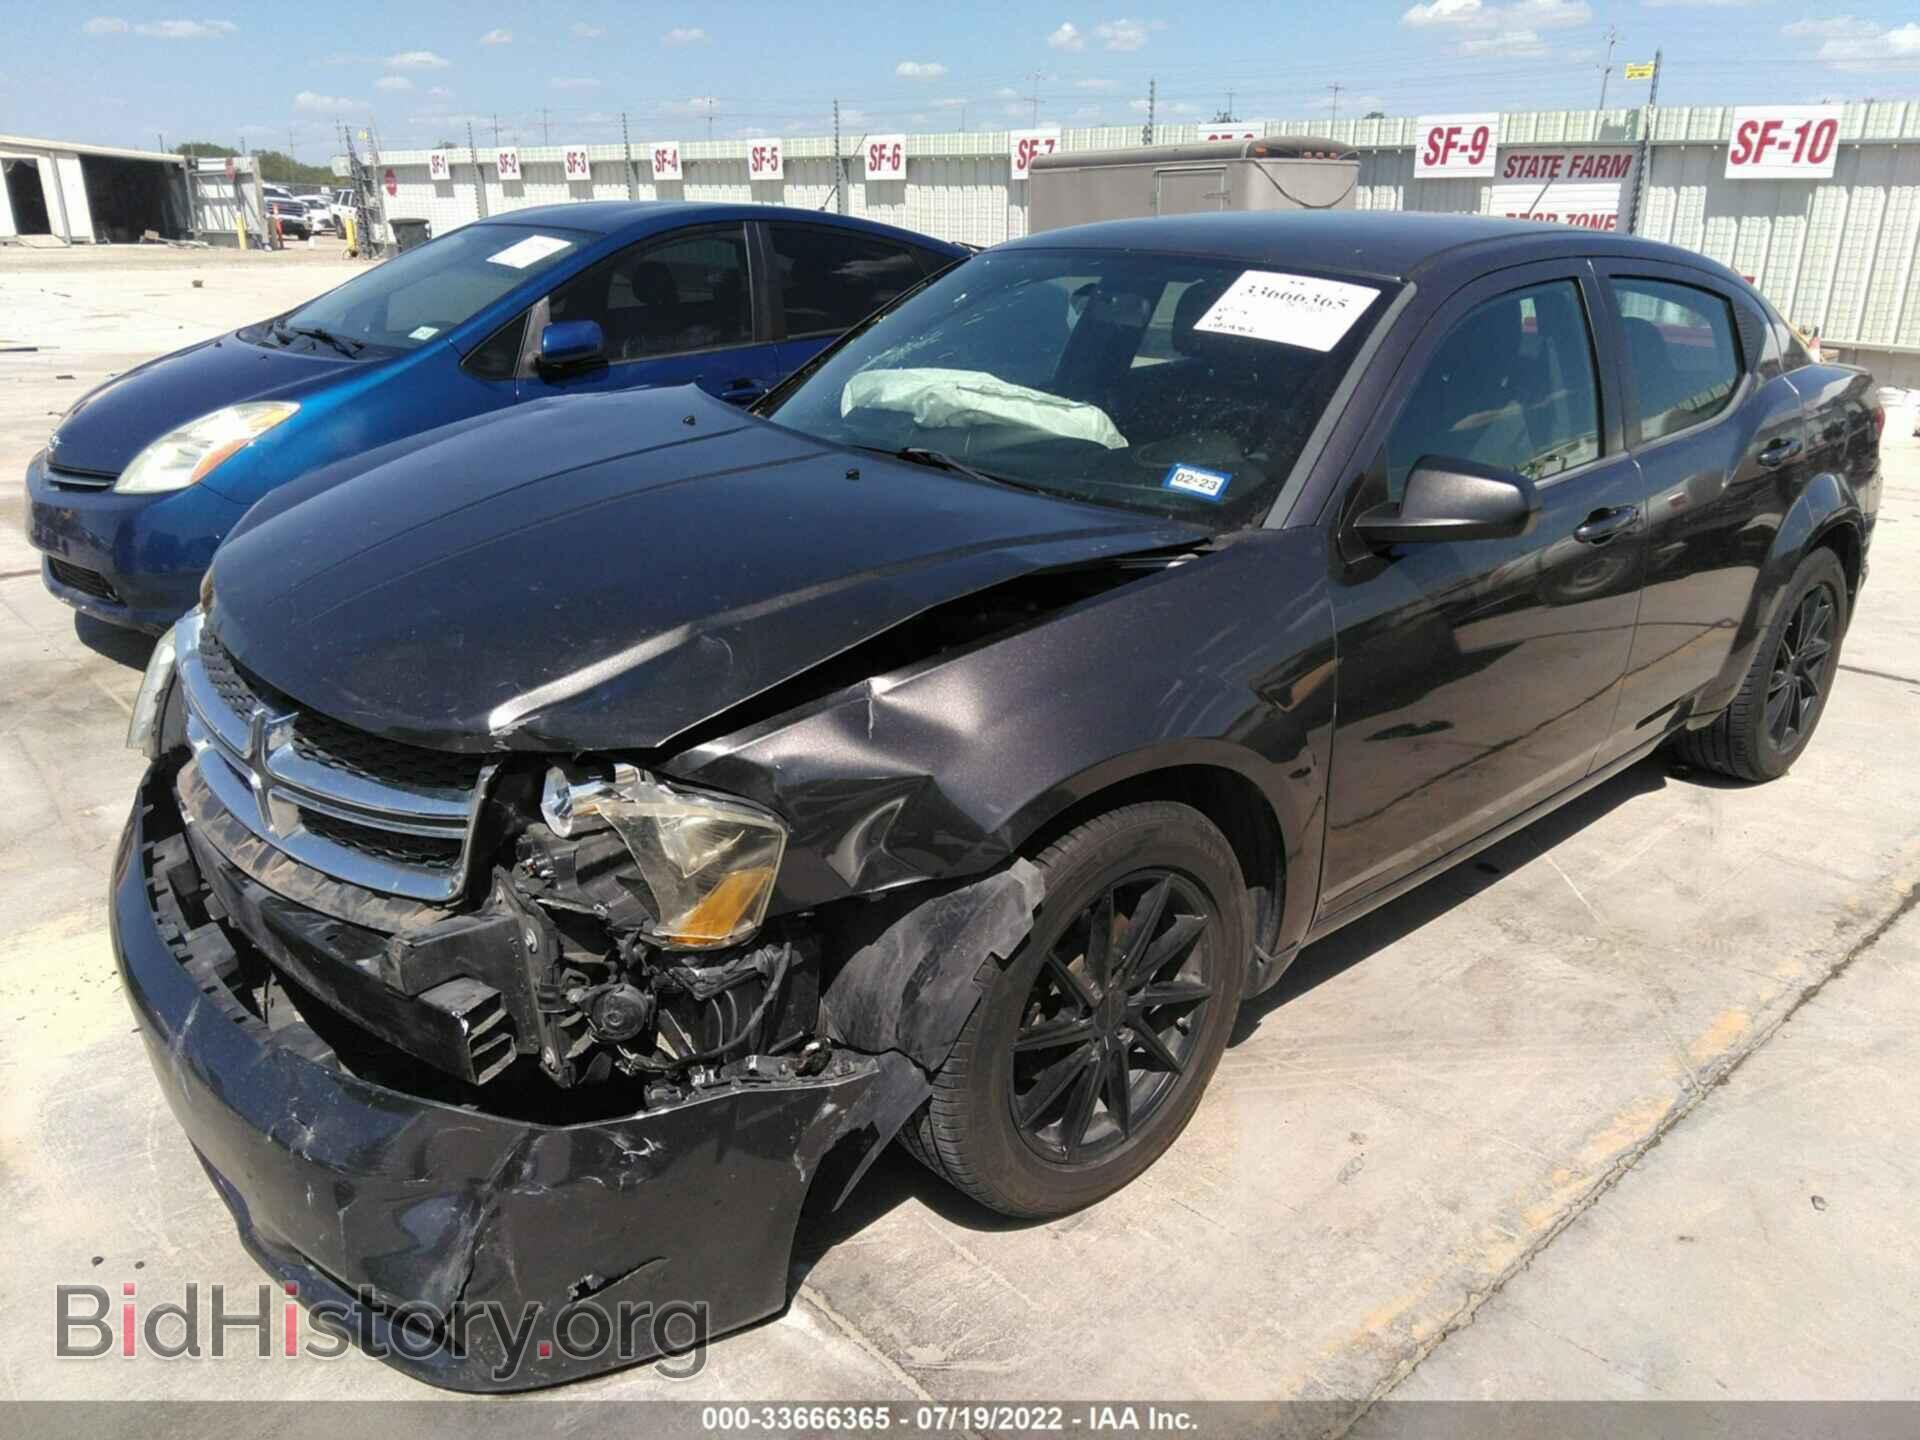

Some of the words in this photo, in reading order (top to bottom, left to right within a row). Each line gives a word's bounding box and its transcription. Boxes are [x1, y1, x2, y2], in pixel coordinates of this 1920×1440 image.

[1423, 126, 1489, 166] SF-9
[1730, 119, 1839, 165] SF-10
[431, 155, 446, 174] SF-1
[499, 153, 517, 174] SF-2
[567, 151, 586, 174] SF-3
[655, 149, 678, 172] SF-4
[751, 146, 778, 172] SF-5
[869, 143, 901, 172] SF-6
[1503, 153, 1564, 178] STATE
[1567, 153, 1633, 178] FARM
